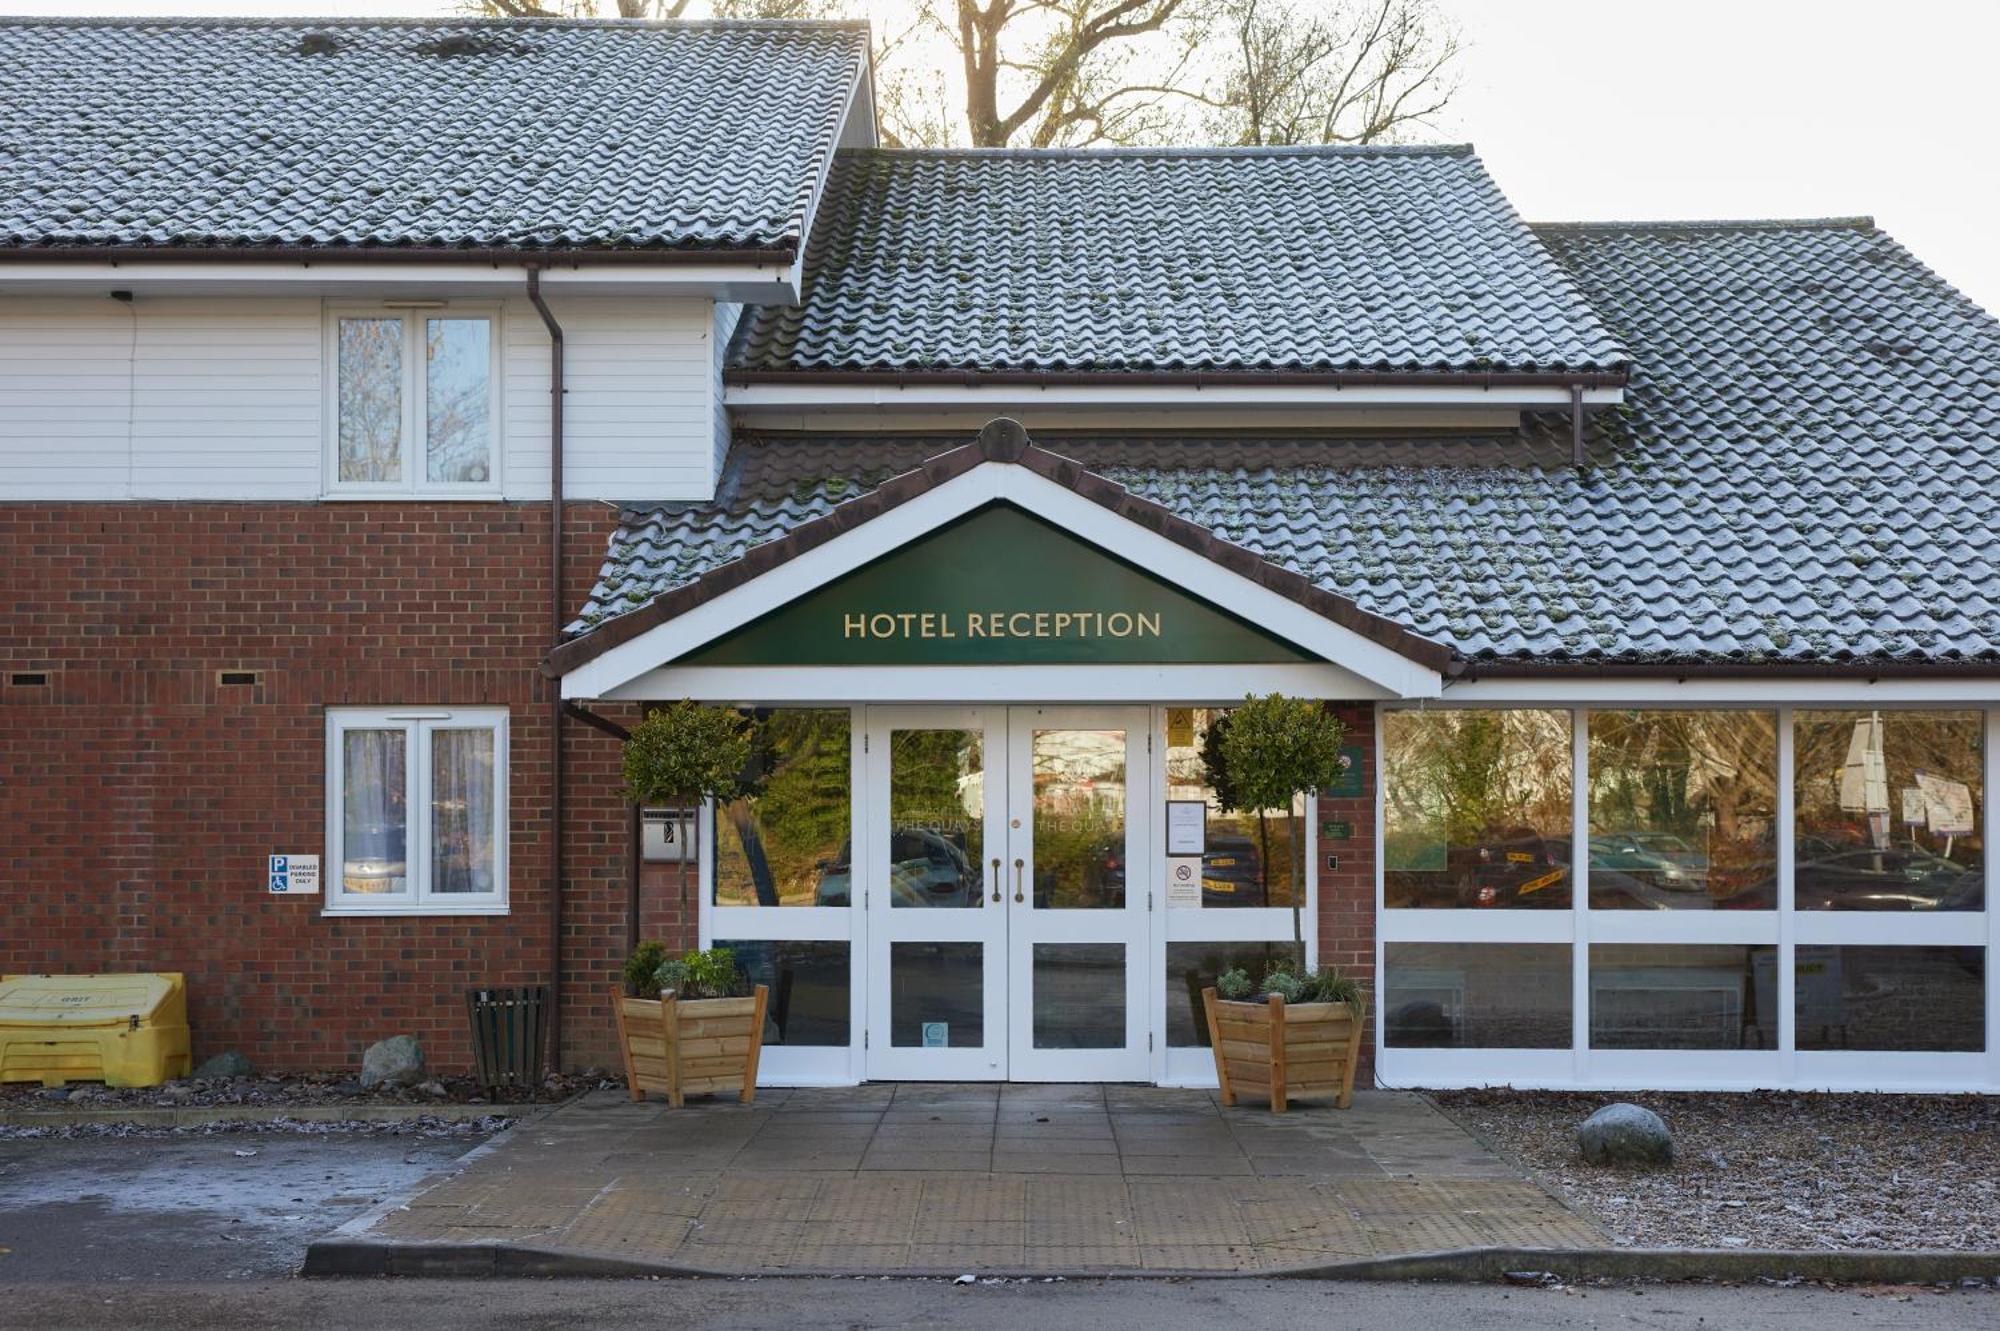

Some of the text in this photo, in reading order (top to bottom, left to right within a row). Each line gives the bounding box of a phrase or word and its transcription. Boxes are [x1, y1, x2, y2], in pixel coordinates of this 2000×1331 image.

[843, 612, 1161, 638] HOTEL RECEPTION
[896, 818, 927, 832] THE
[1036, 820, 1067, 833] THE
[274, 858, 285, 871] P
